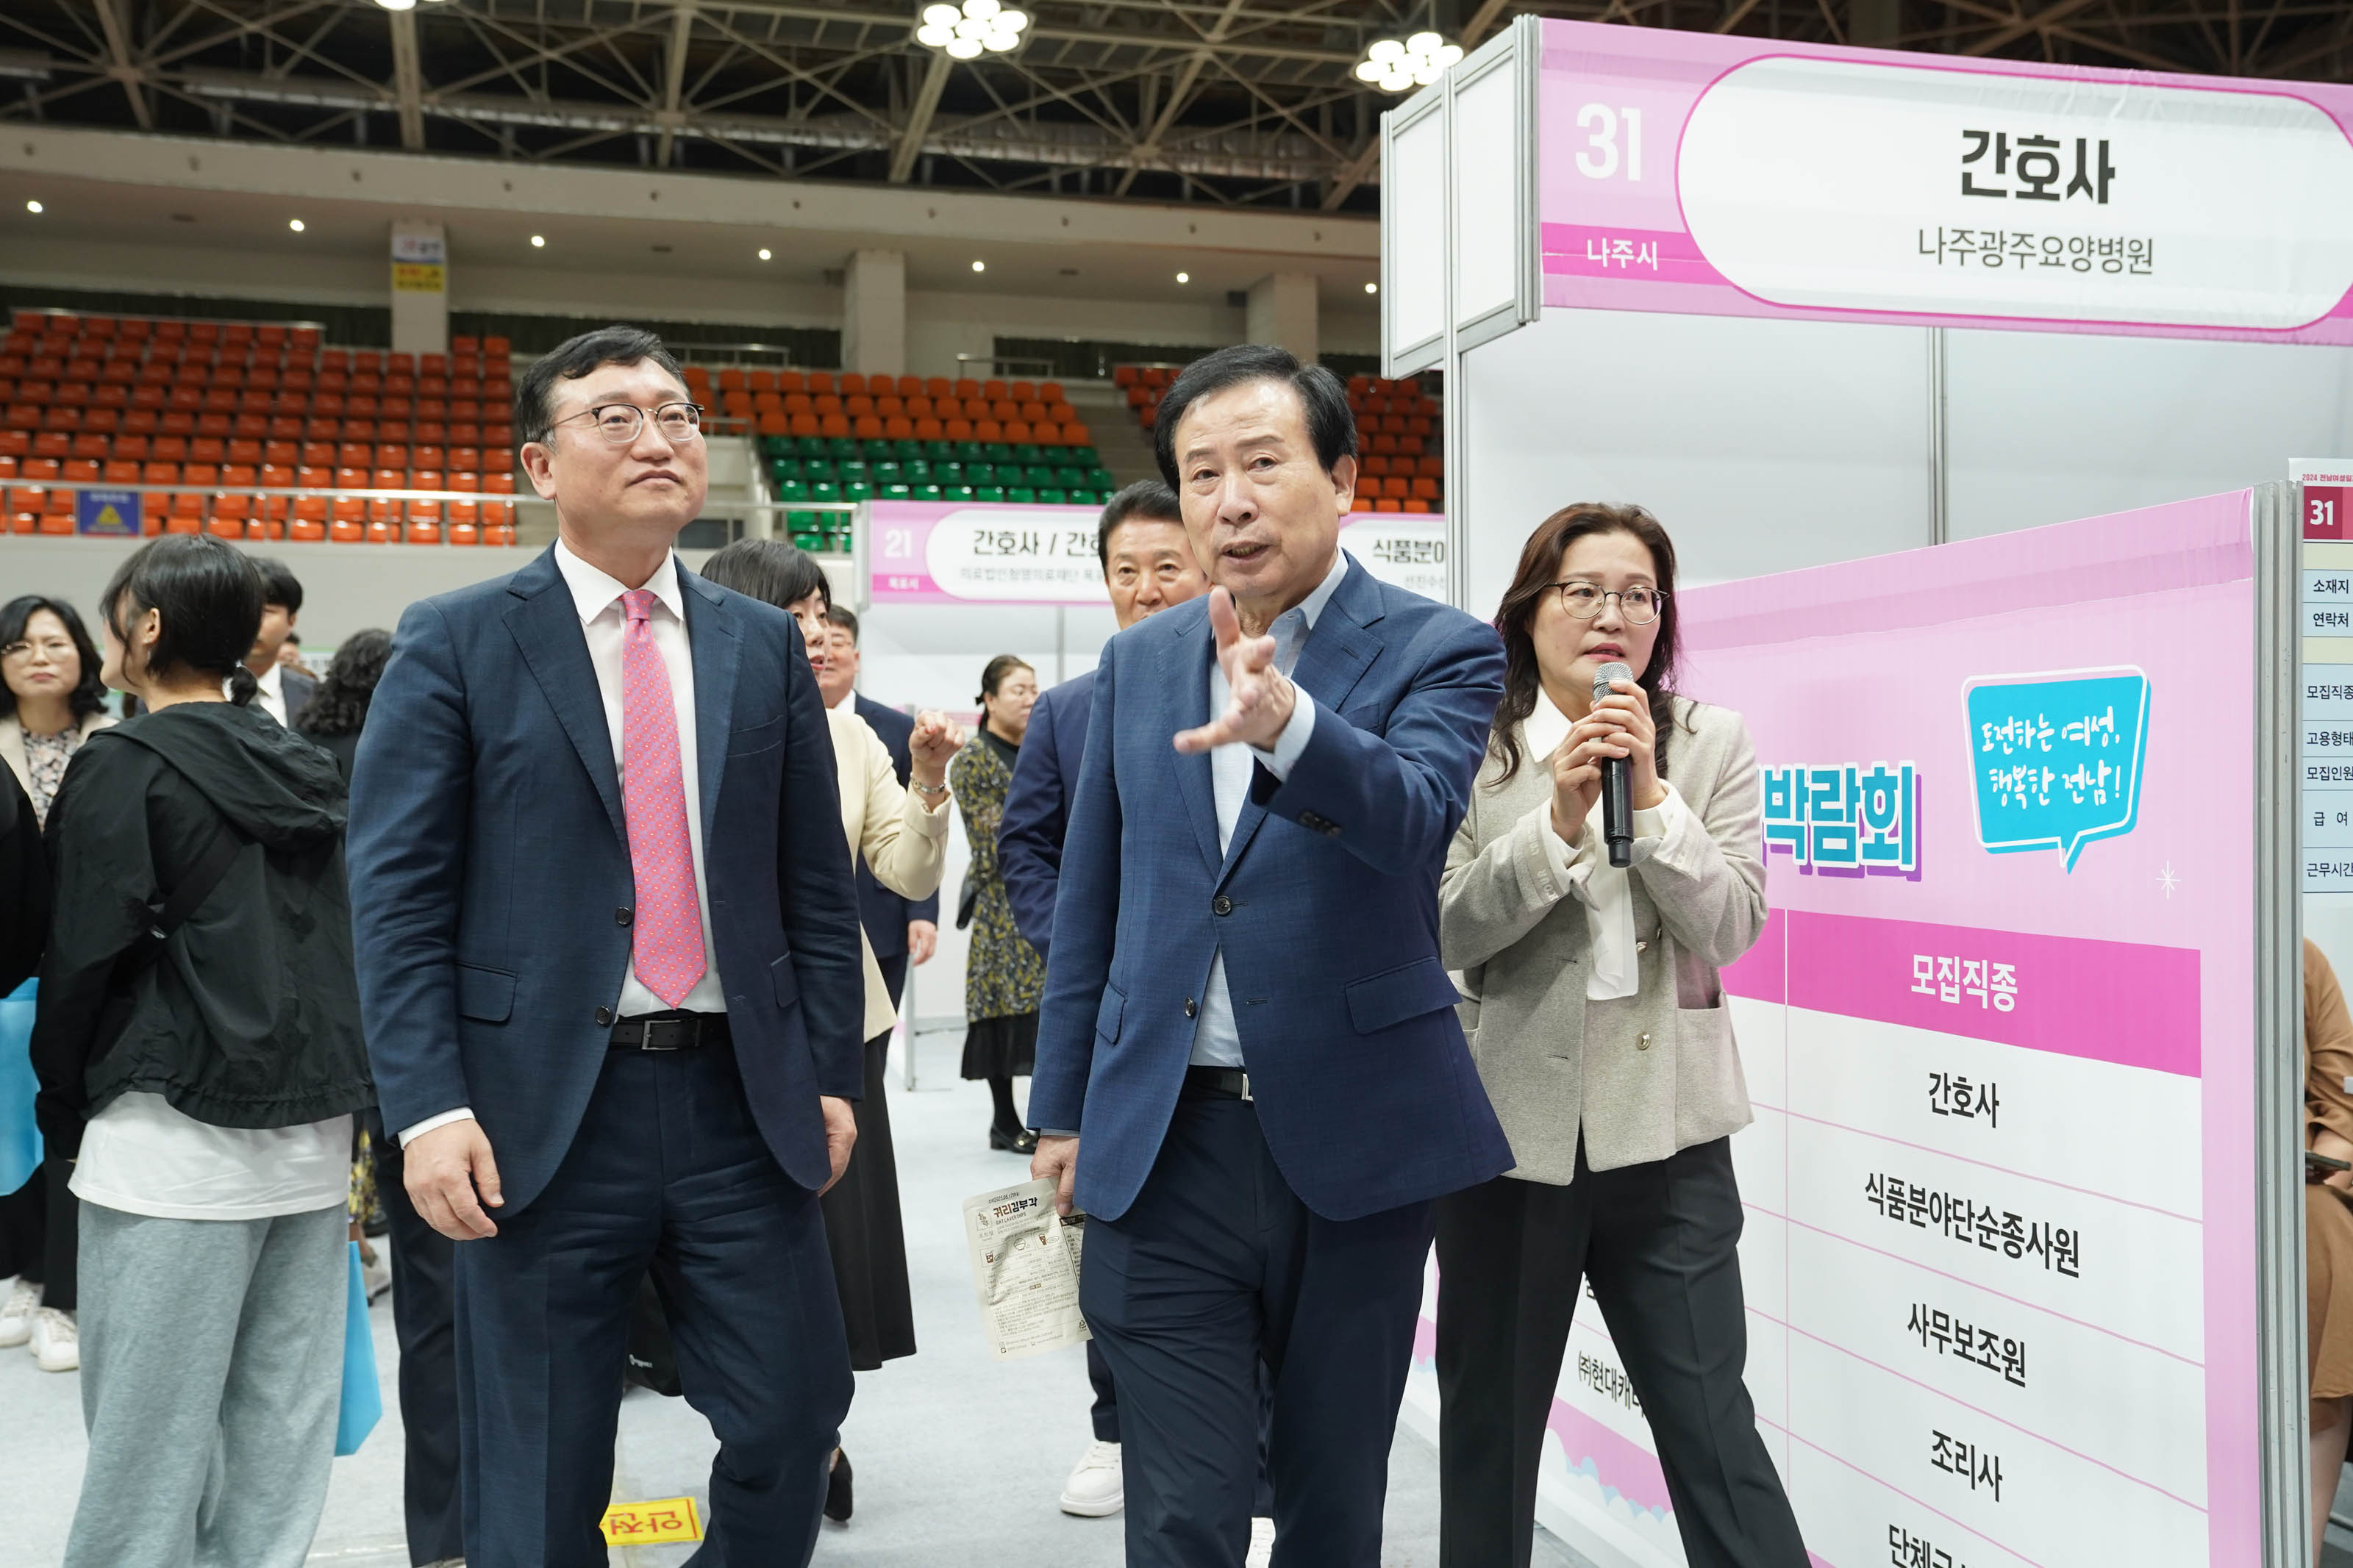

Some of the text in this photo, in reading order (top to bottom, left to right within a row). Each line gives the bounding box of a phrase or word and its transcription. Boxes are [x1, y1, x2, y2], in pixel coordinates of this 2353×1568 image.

[1575, 103, 1642, 181] 31
[1962, 129, 2115, 204] 간호사
[1587, 237, 1658, 271] 나주시
[1919, 226, 2153, 275] 나주광주요양병원
[2319, 474, 2353, 482] 전남여성일
[2310, 499, 2334, 526] 31
[884, 529, 913, 559] 21
[974, 530, 1039, 556] 간호사
[1049, 533, 1057, 556] /
[2313, 579, 2349, 594] 소재지
[2313, 612, 2349, 627] 연락처
[2307, 684, 2353, 700] 모집직종
[1982, 706, 2121, 754] 도전하는 여성,
[2307, 731, 2353, 747] 고용형태
[1990, 759, 2121, 809] 행복한 전남!
[2307, 766, 2353, 782] 모집인원
[1763, 760, 1917, 873] 박람회
[1911, 954, 2018, 1012] 모집직종
[1929, 1072, 1999, 1128] 간호사
[993, 1197, 1038, 1218] 귀리김부각
[1865, 1173, 2079, 1278] 식품분야단순종사원
[1908, 1303, 2026, 1388] 사무보조원
[1931, 1429, 2002, 1503] 조리사
[608, 1511, 682, 1536] 안전
[1889, 1524, 1966, 1568] 단체
